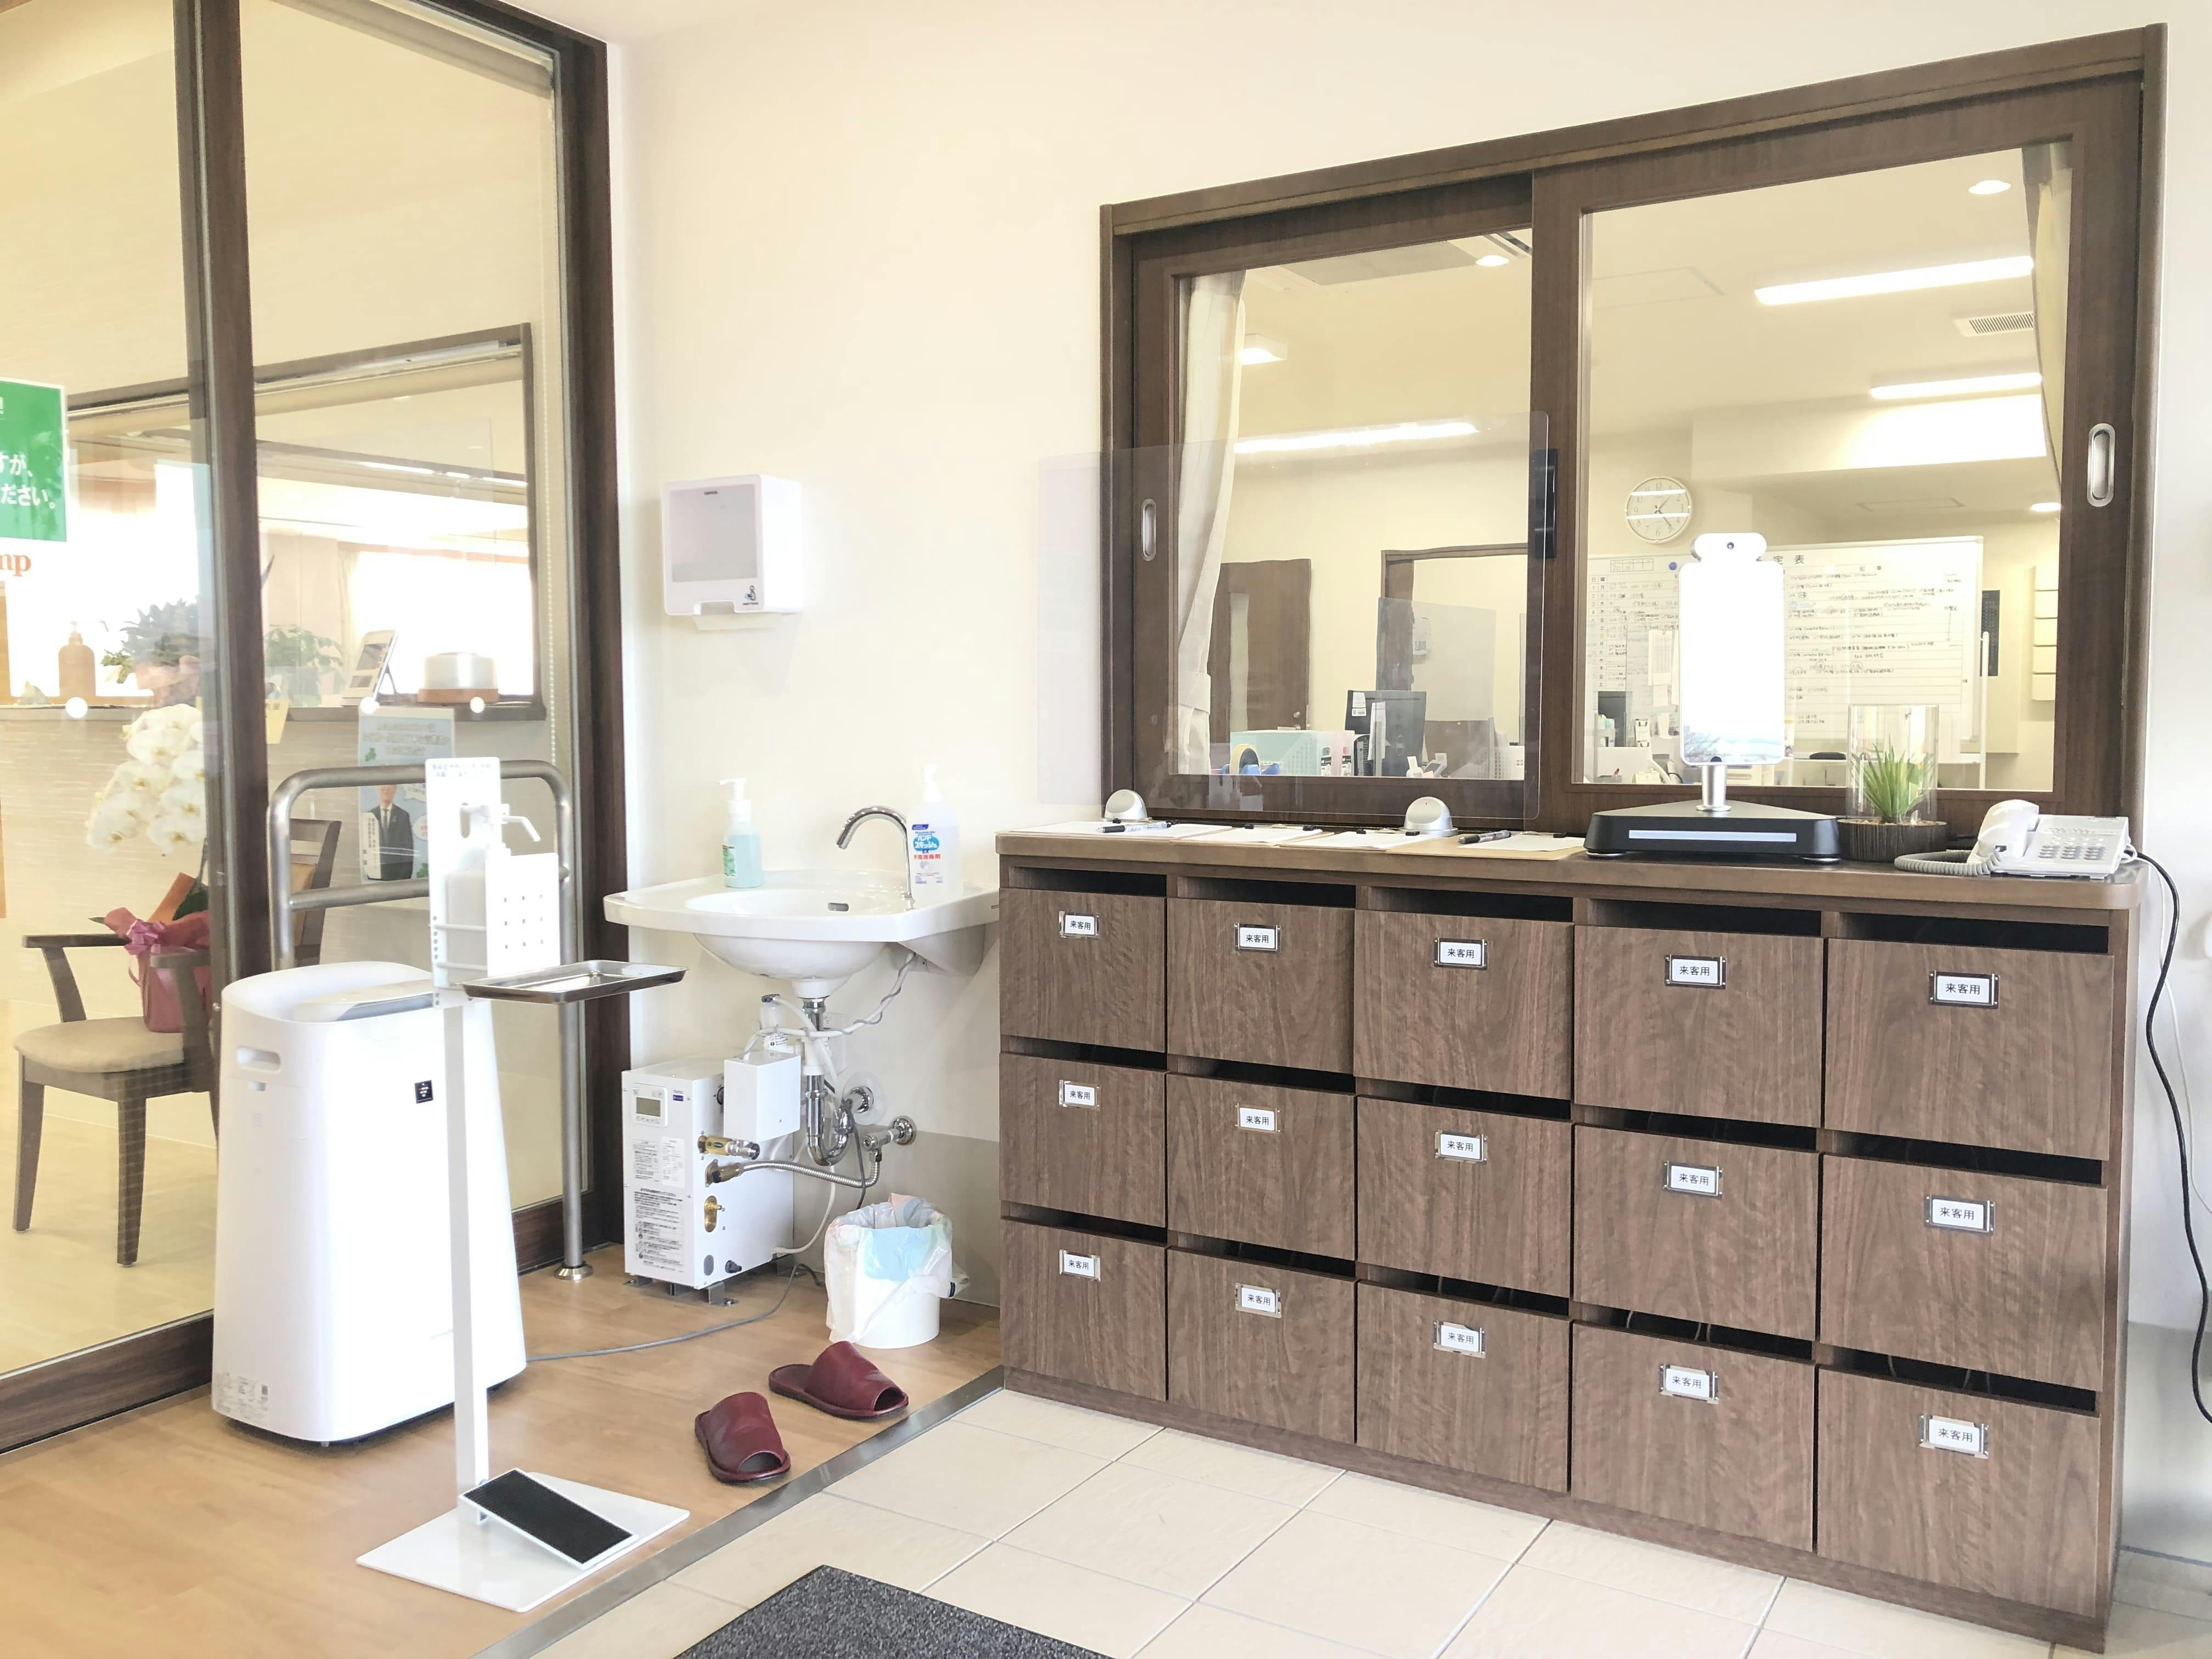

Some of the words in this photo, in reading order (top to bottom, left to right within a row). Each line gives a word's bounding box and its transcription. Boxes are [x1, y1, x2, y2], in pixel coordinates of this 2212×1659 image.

[1, 483, 55, 509] ださい。
[1070, 920, 1091, 931] 来客用
[1245, 934, 1269, 944] 来客用
[1447, 947, 1475, 959] 来客用
[1679, 965, 1710, 977] 来客用
[1945, 983, 1981, 995] 来客用
[1069, 1090, 1091, 1101] 来客用
[1245, 1115, 1269, 1126] 来客用
[1447, 1140, 1474, 1152] 来客用
[1679, 1172, 1709, 1186] 来客用
[1939, 1206, 1975, 1220] 来客用
[1068, 1259, 1090, 1271] 来客用
[1247, 1294, 1271, 1306] 来客用
[1447, 1331, 1474, 1345] 来客用
[1672, 1375, 1702, 1389] 来客用
[1939, 1427, 1973, 1443] 来客用
